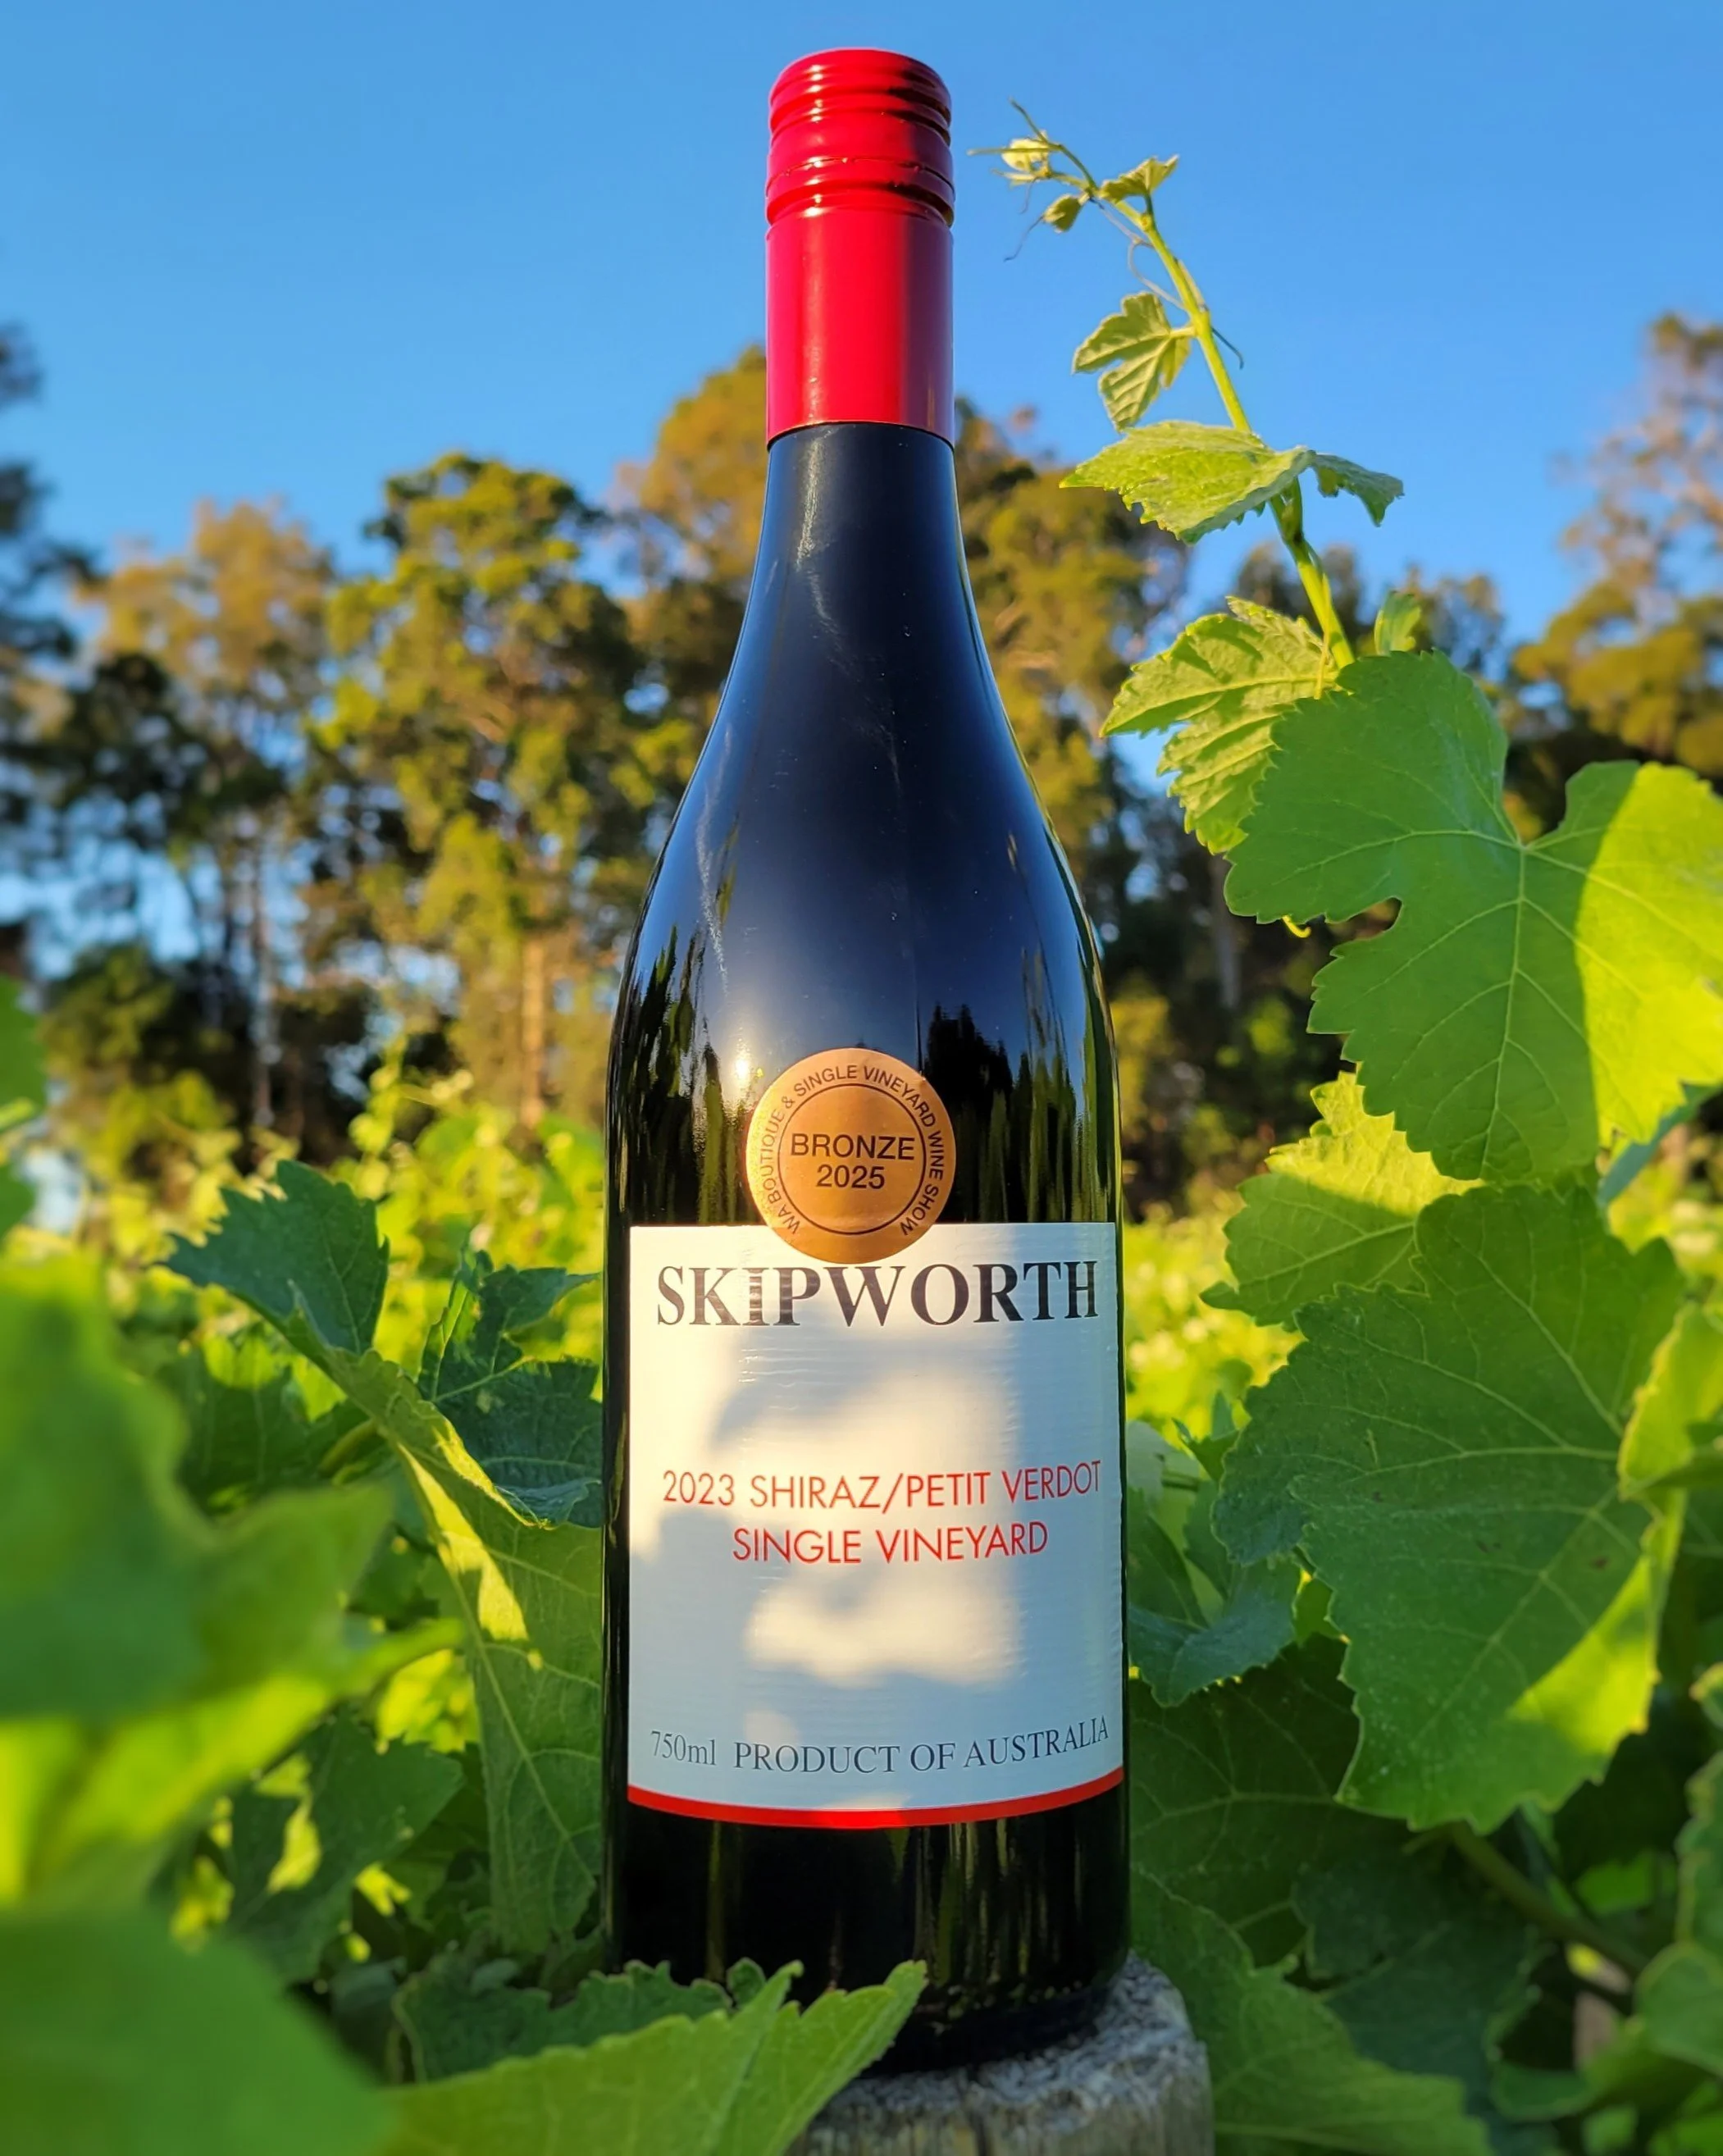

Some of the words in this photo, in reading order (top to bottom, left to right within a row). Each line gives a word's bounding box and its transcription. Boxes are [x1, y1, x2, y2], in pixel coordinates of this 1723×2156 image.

[781, 1096, 795, 1110] &
[794, 1064, 859, 1097] SINGLE
[863, 1065, 937, 1128] VINEYARD
[760, 1110, 785, 1205] BOUTIQUE
[790, 1133, 915, 1160] BRONZE
[928, 1130, 945, 1182] WINE
[816, 1165, 886, 1189] 2025
[777, 1206, 801, 1234] WA
[899, 1183, 939, 1236] SHOW
[657, 1260, 1100, 1328] SKIPWORTH
[663, 1470, 736, 1506] 2023
[750, 1471, 991, 1515] SHIRAZ/PETIT
[1001, 1460, 1101, 1503] VERDOT
[733, 1528, 862, 1564] SINGLE
[876, 1521, 1048, 1563] VINEYARD
[650, 1730, 716, 1766] 750ml
[734, 1741, 900, 1775] PRODUCT
[909, 1741, 956, 1773] OF
[963, 1714, 1110, 1767] AUSTRALIA
